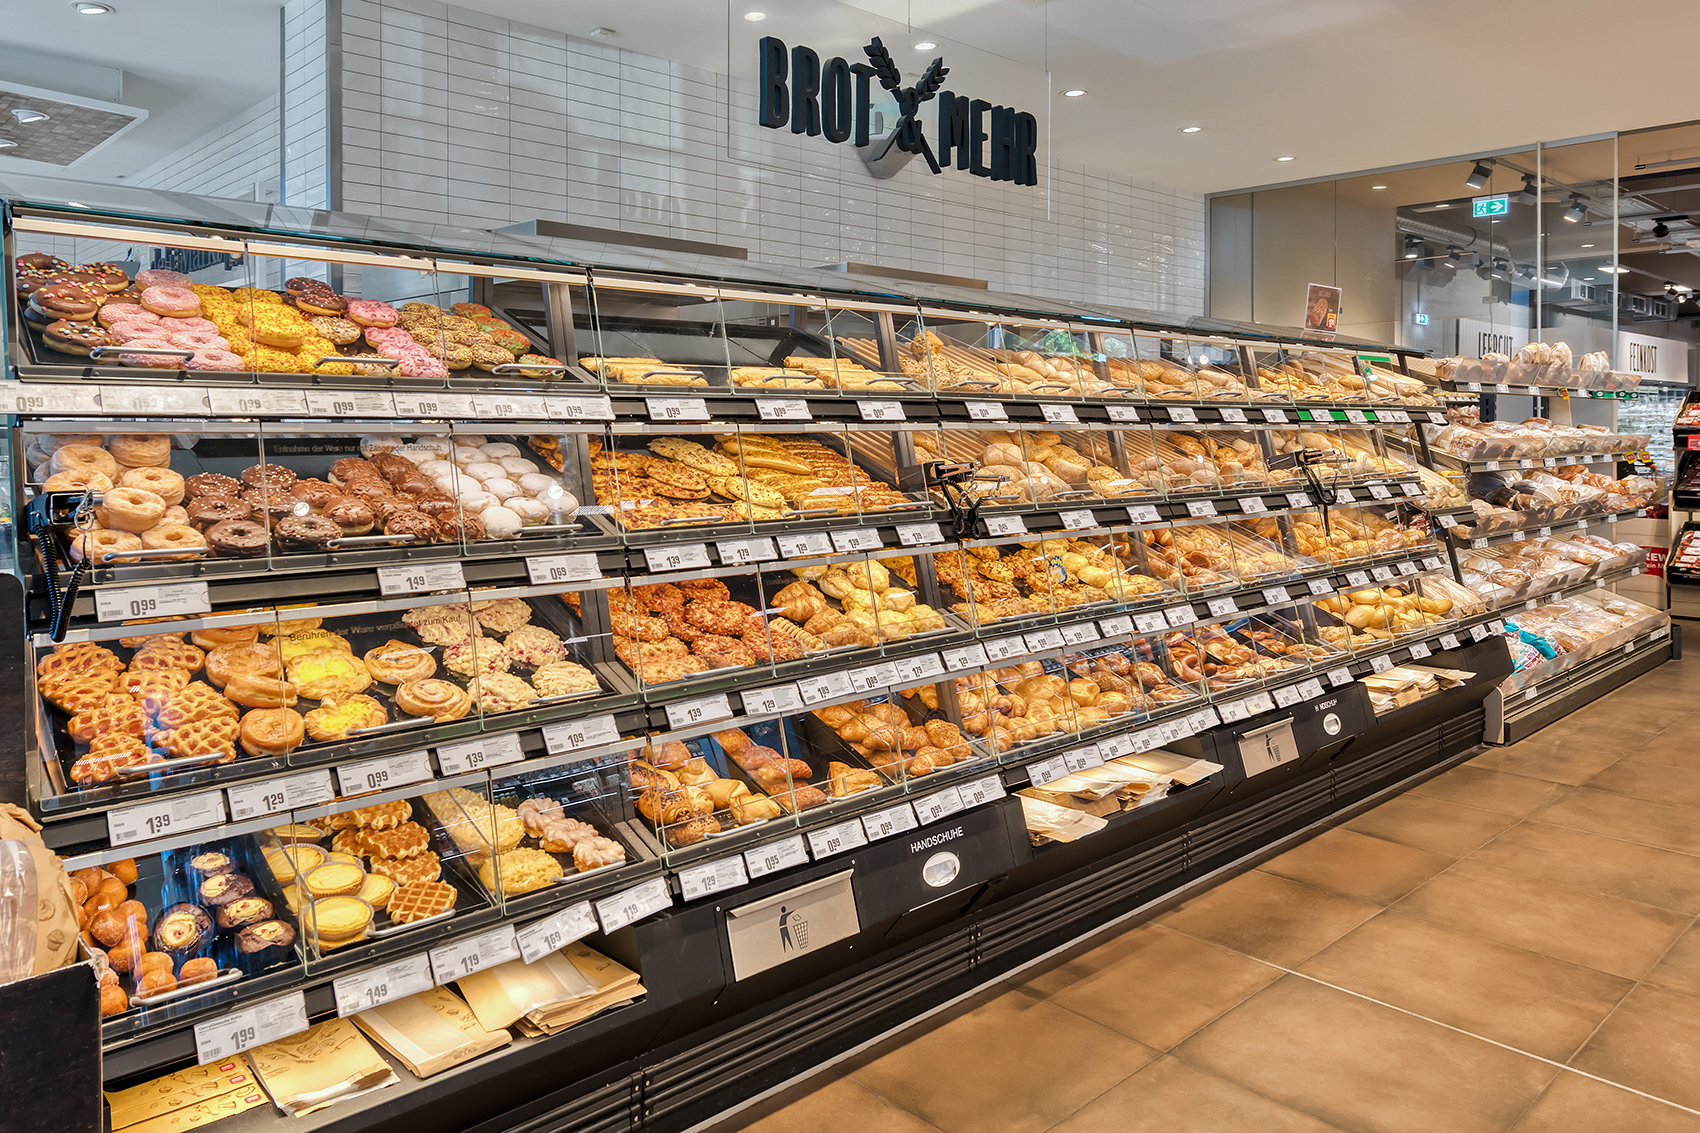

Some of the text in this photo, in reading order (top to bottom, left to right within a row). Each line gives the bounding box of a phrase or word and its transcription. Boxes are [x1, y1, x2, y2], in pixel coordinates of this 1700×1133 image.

[760, 36, 878, 147] BROT
[939, 90, 1037, 186] MEHR
[1630, 342, 1657, 373] FEINKOST
[16, 396, 43, 412] 0.99
[333, 401, 354, 415] 0.99
[419, 402, 438, 415] 0.99
[567, 405, 583, 417] 0.99
[666, 407, 680, 418] 0.99
[369, 444, 390, 454] Zange
[407, 443, 442, 452] Handschuh.
[667, 556, 681, 568] 1.39
[737, 548, 750, 560] 1.79
[550, 566, 567, 580] 0.69
[406, 575, 425, 590] 1.49
[131, 599, 156, 616] 0.99
[289, 631, 331, 642] Berühren
[351, 625, 374, 635] Ware
[423, 617, 440, 626] zum
[443, 614, 463, 624] Kauf.
[763, 699, 775, 712] 1.29
[688, 707, 702, 721] 1.39
[567, 732, 584, 748] 1.09
[465, 751, 484, 768] 1.39
[367, 770, 388, 789] 0.99
[262, 792, 285, 811] 1.29
[146, 814, 171, 834] 1.39
[880, 820, 894, 835] 0.99
[826, 838, 841, 852] 0.99
[910, 826, 965, 856] HANDSCHUHE
[765, 855, 780, 870] 0.95
[702, 875, 717, 891] 1.29
[623, 903, 640, 921] 1.19
[544, 931, 562, 951] 1.69
[461, 954, 480, 973] 1.19
[366, 984, 388, 1006] 1.49
[230, 1026, 256, 1050] 1.99
